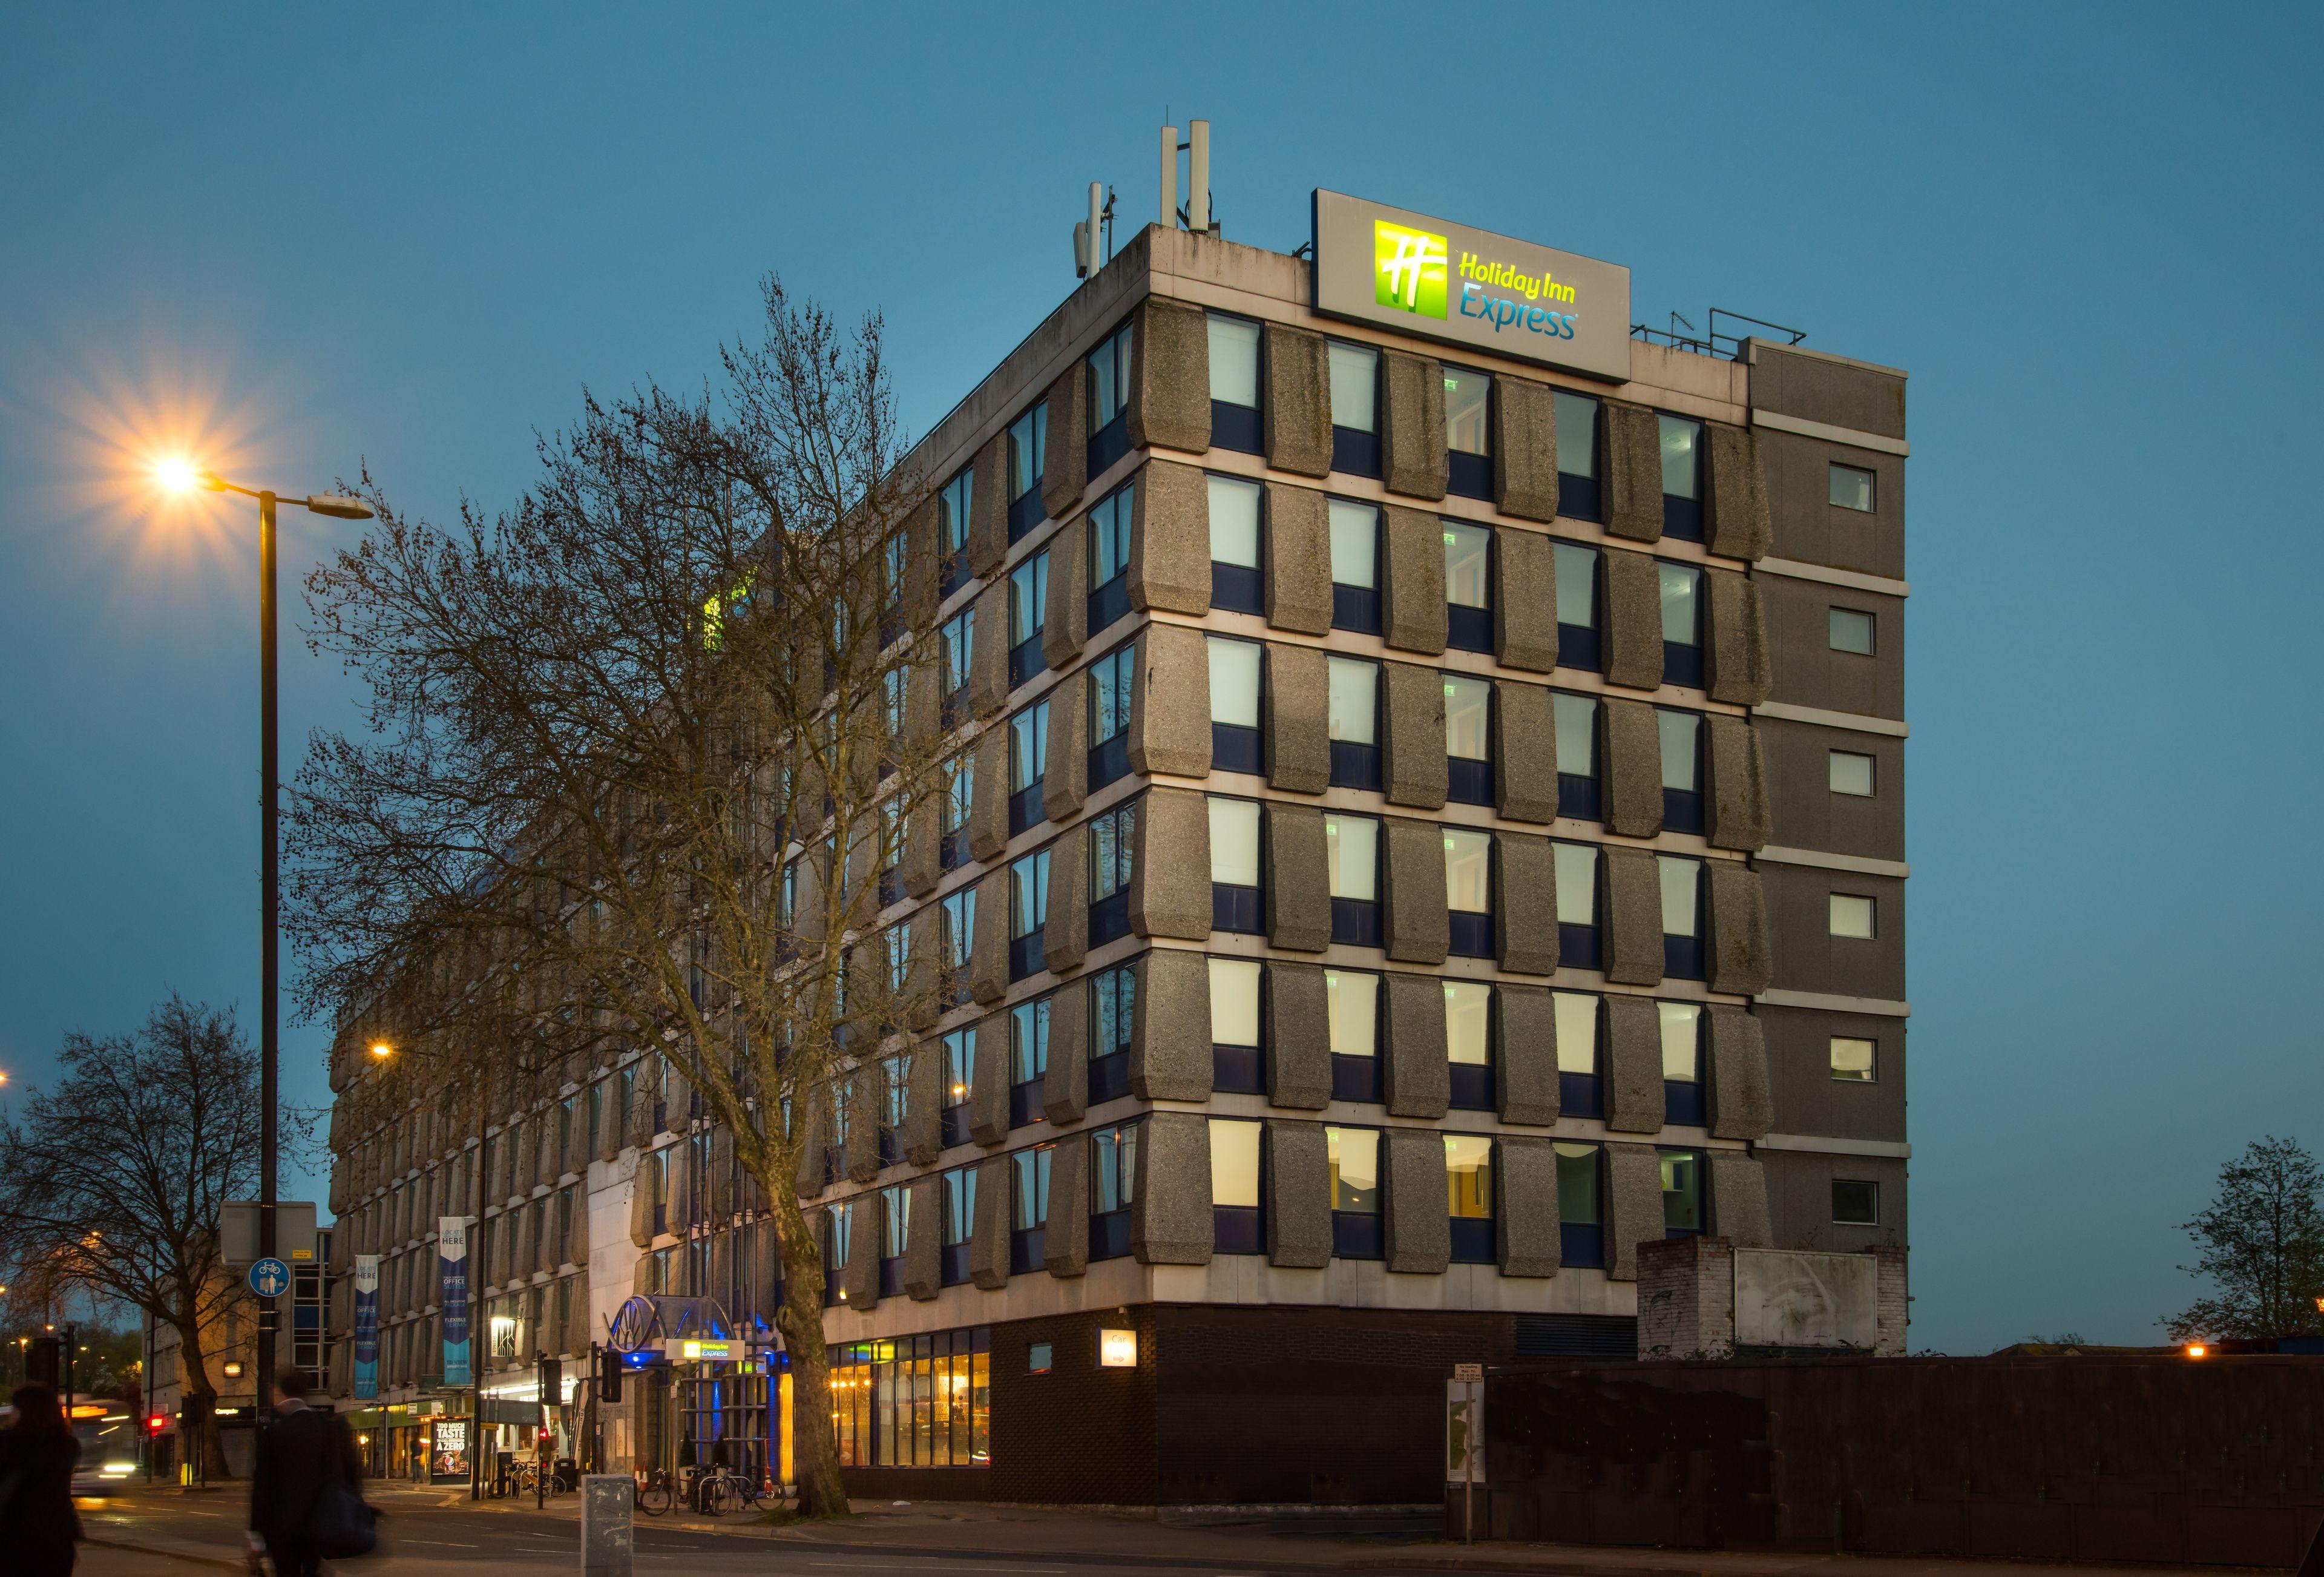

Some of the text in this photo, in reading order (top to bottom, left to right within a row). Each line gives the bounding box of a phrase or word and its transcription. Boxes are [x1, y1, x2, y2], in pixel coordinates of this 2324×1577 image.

[1459, 252, 1575, 304] Holiday Inn
[1460, 281, 1576, 340] Express
[1112, 1334, 1126, 1343] Car
[436, 1428, 465, 1438] TASTE
[436, 1442, 465, 1451] A ZERO
